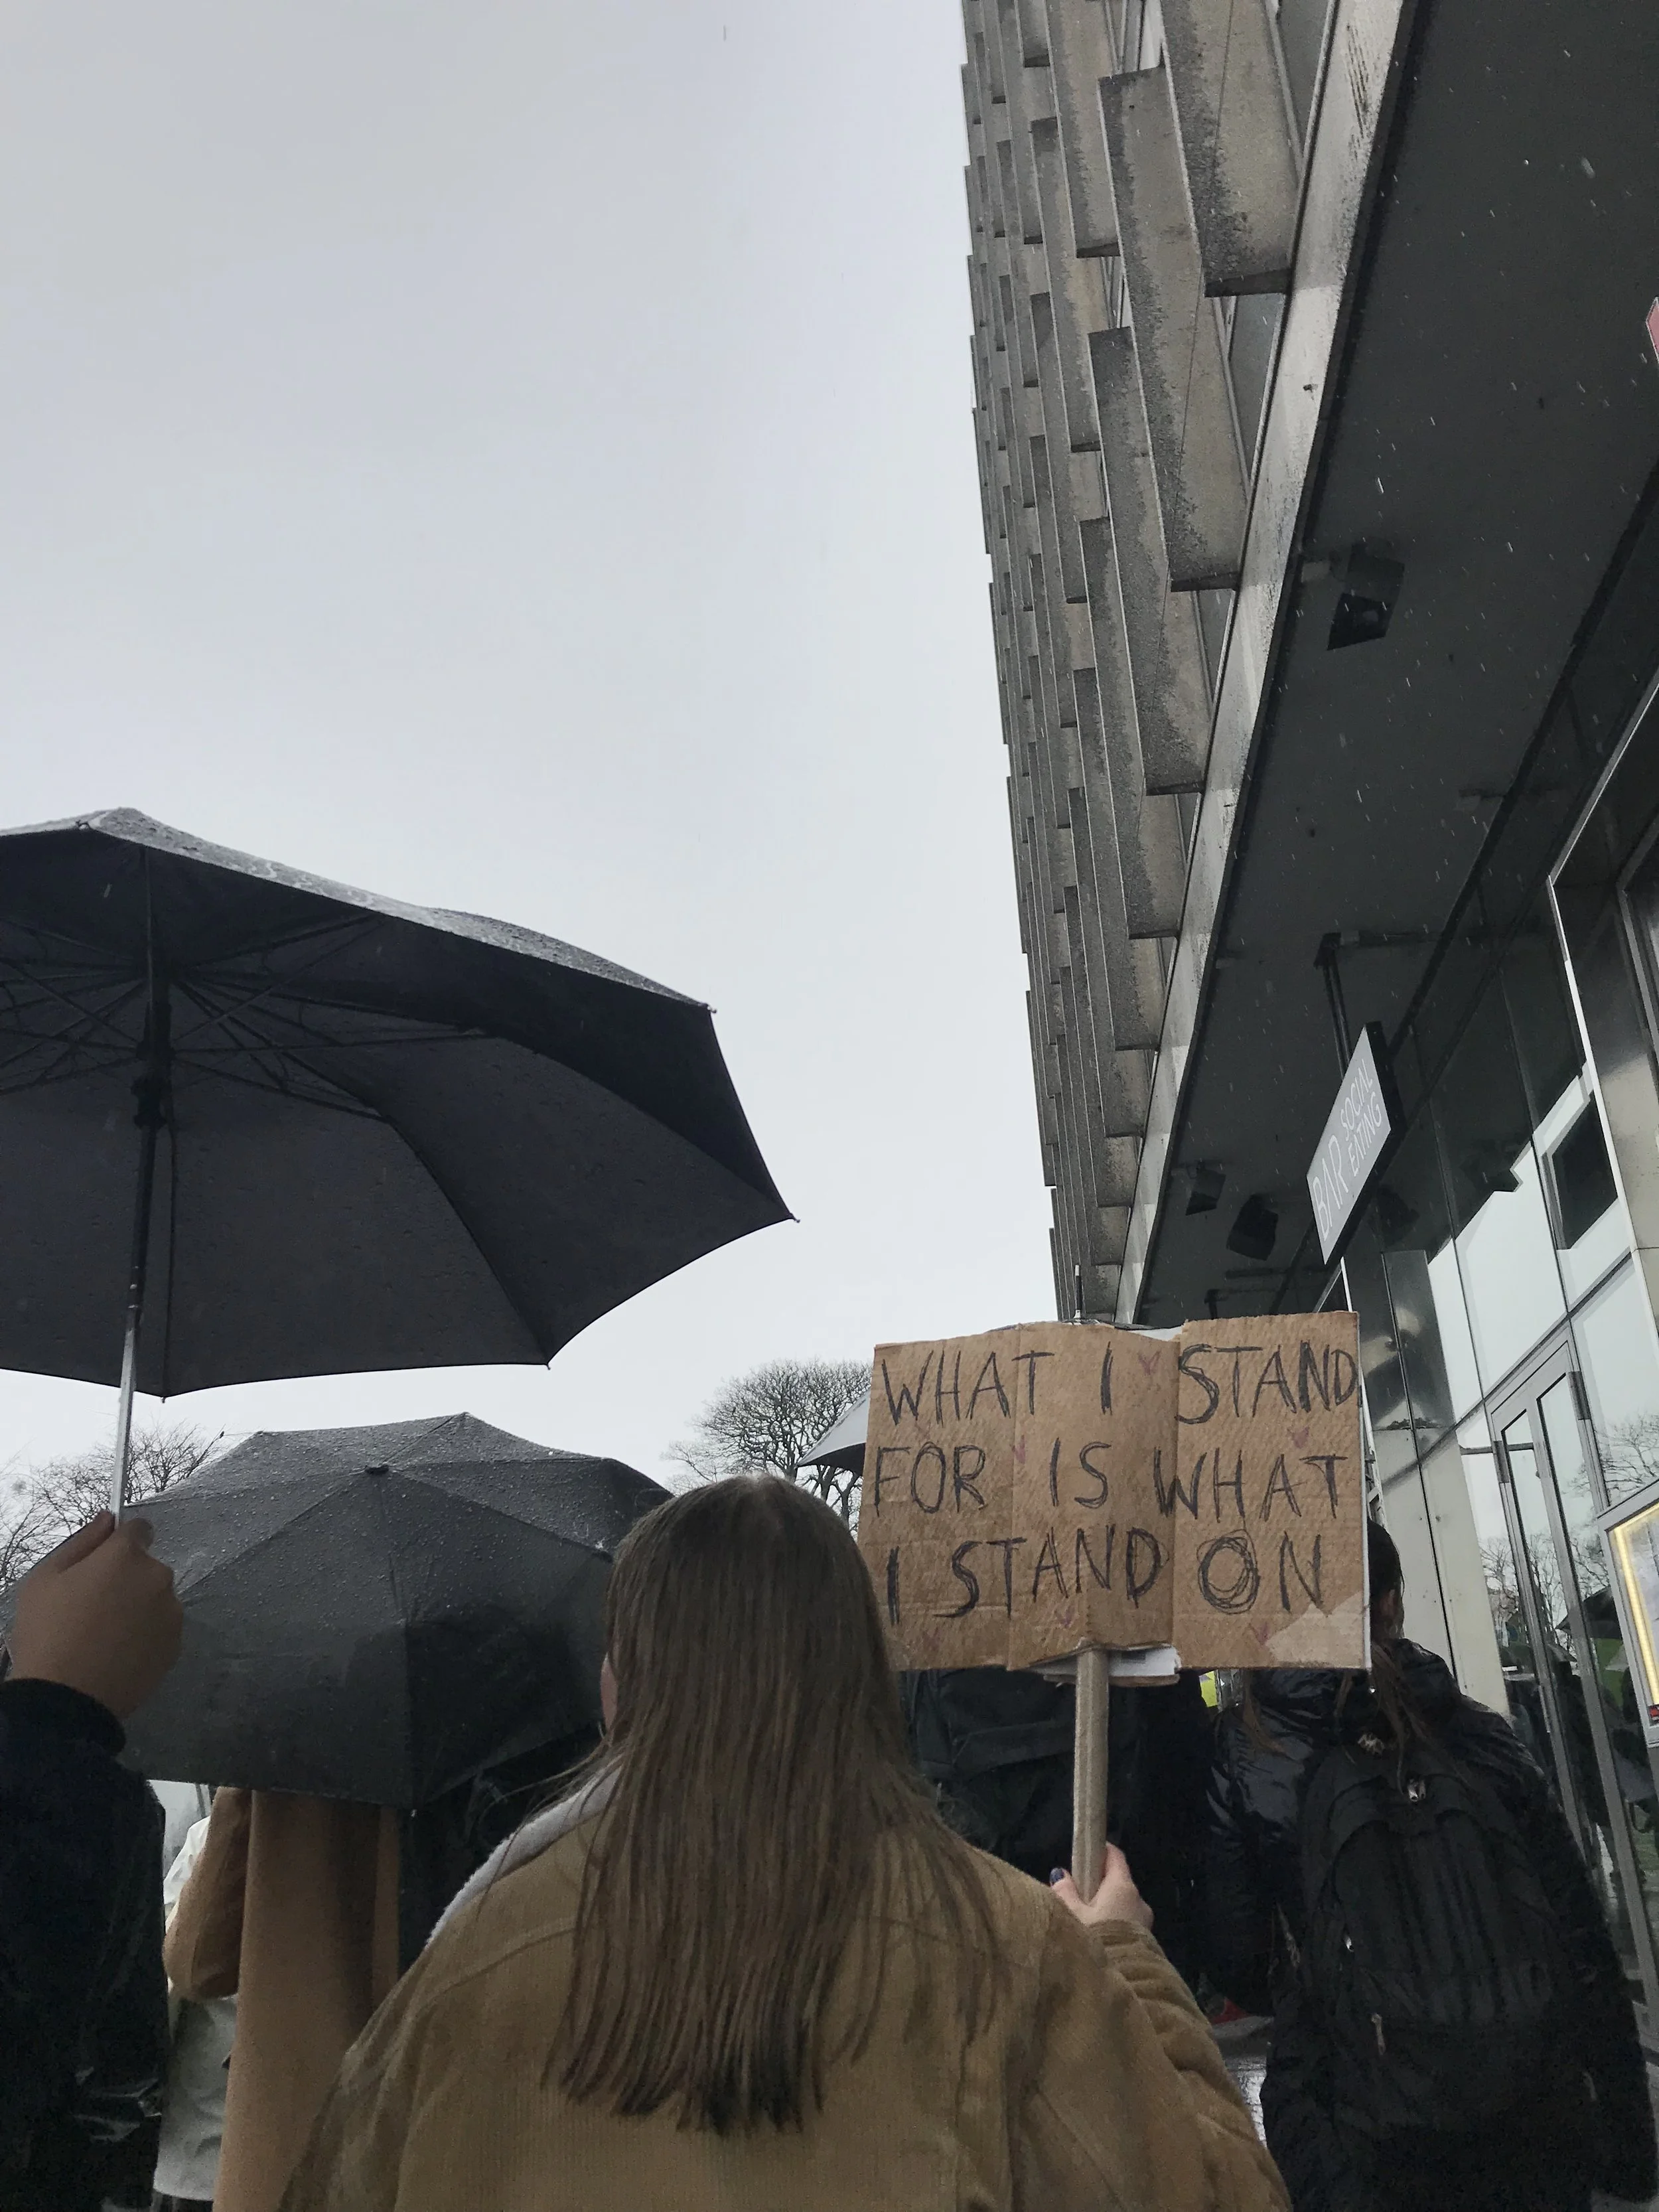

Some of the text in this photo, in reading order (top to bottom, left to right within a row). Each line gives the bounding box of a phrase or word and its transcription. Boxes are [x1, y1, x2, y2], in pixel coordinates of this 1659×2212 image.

[1340, 1059, 1373, 1142] SOCIAL
[1348, 1091, 1382, 1177] EATING
[1313, 1134, 1348, 1241] BAR
[881, 1339, 1358, 1426] WHAT I STAND
[874, 1436, 1348, 1523] FOR IS WHAT
[886, 1523, 1325, 1626] I STAND ON
